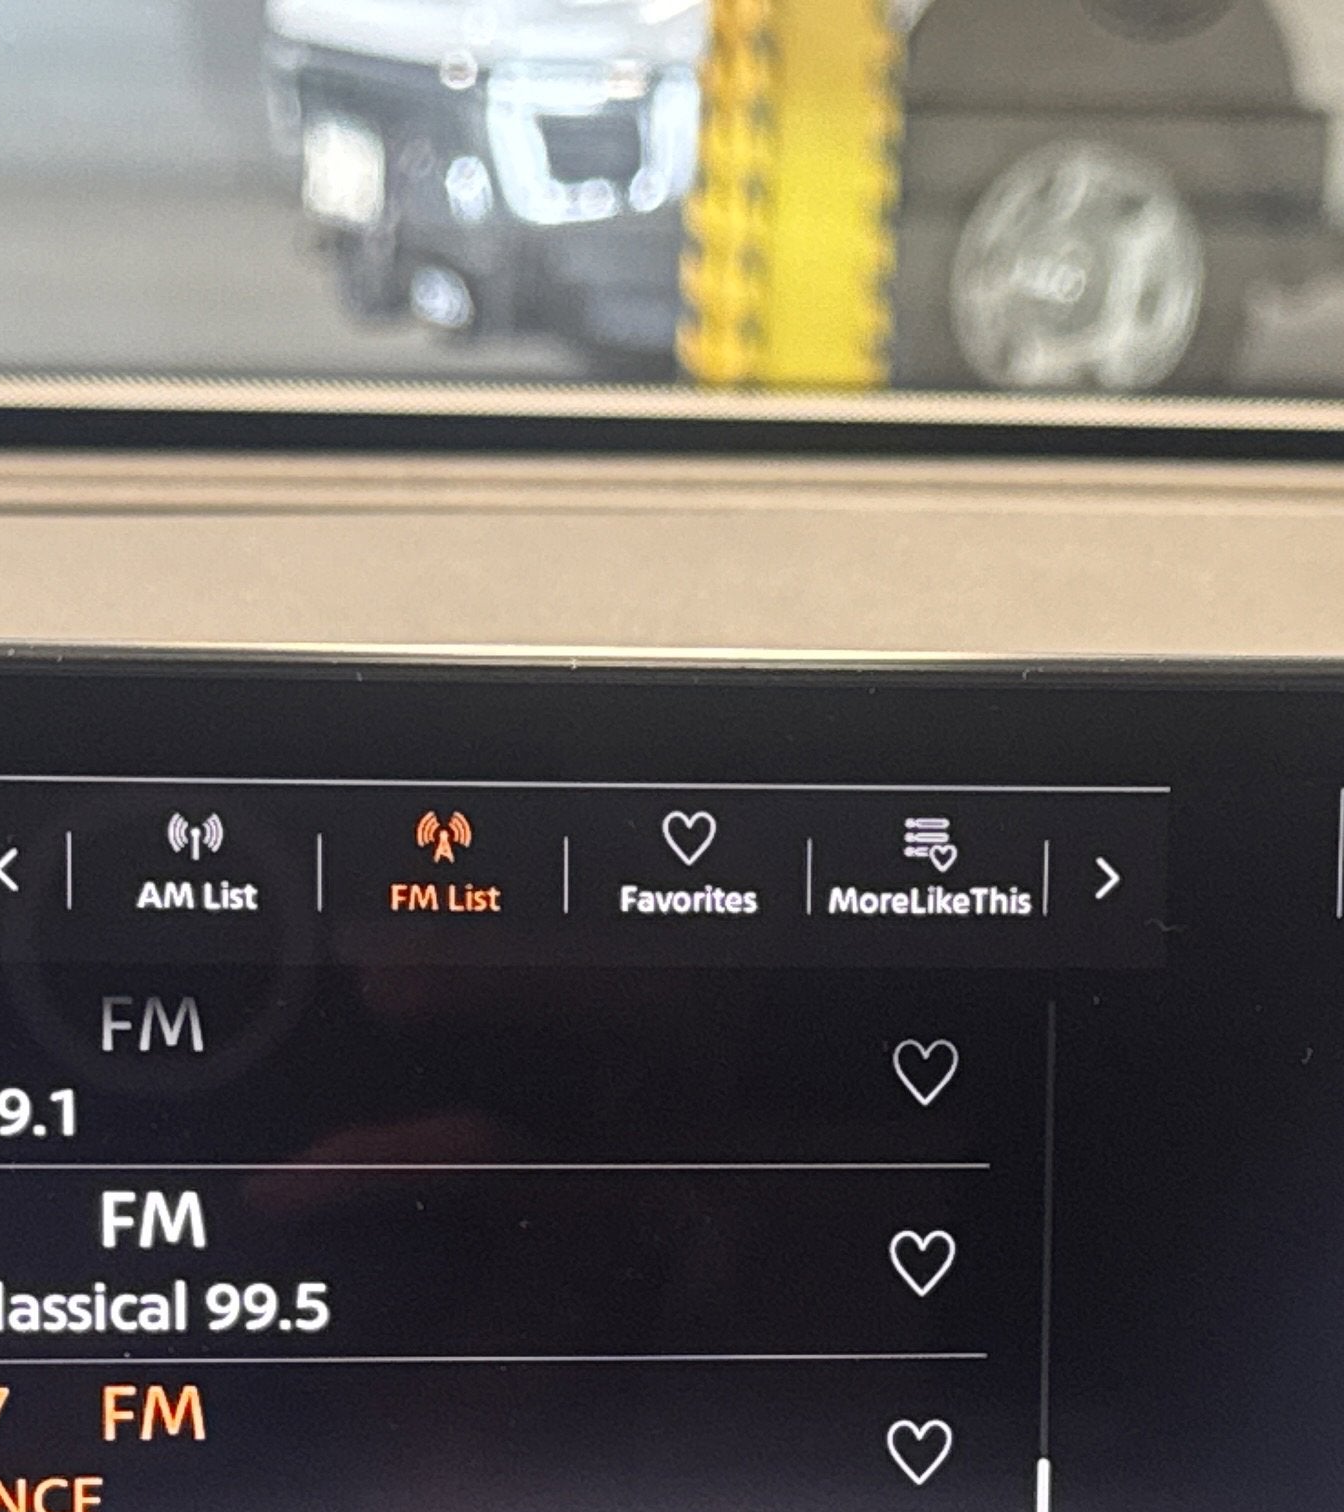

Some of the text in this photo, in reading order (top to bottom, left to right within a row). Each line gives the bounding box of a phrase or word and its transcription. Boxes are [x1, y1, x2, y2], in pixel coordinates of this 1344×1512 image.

[137, 881, 257, 910] AM List
[391, 884, 500, 911] FM List
[621, 885, 758, 913] Favorites
[829, 886, 1032, 914] MoreLikeThis
[103, 997, 203, 1051] FM
[102, 1191, 205, 1248] FM
[206, 1283, 329, 1331] 99.5
[103, 1386, 205, 1441] FM
